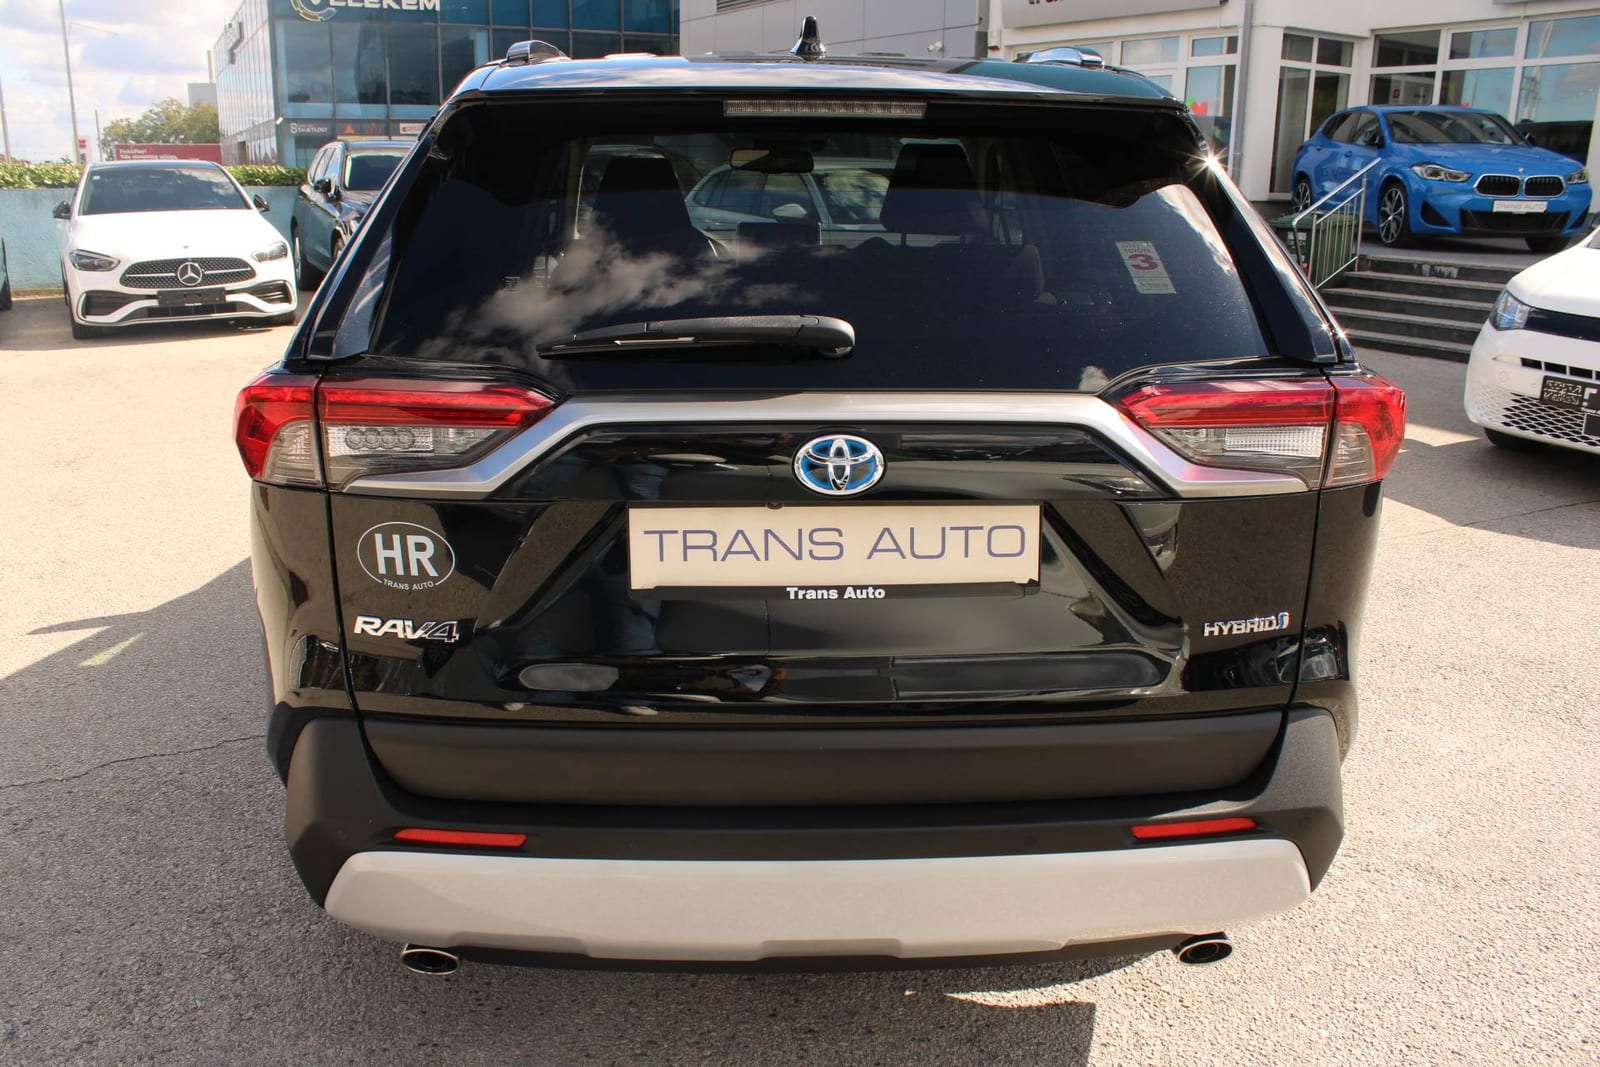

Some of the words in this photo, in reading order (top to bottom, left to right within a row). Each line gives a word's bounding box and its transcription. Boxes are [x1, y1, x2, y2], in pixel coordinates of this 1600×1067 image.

[1128, 254, 1158, 270] 3
[643, 527, 844, 562] TRANS
[866, 524, 1026, 560] AUTO
[374, 533, 439, 577] HR
[383, 579, 409, 590] TRANS
[412, 581, 434, 590] AUTO
[786, 586, 839, 600] Trans
[844, 586, 885, 600] Auto
[354, 616, 459, 643] RAV4
[1203, 615, 1277, 637] HYBRID
